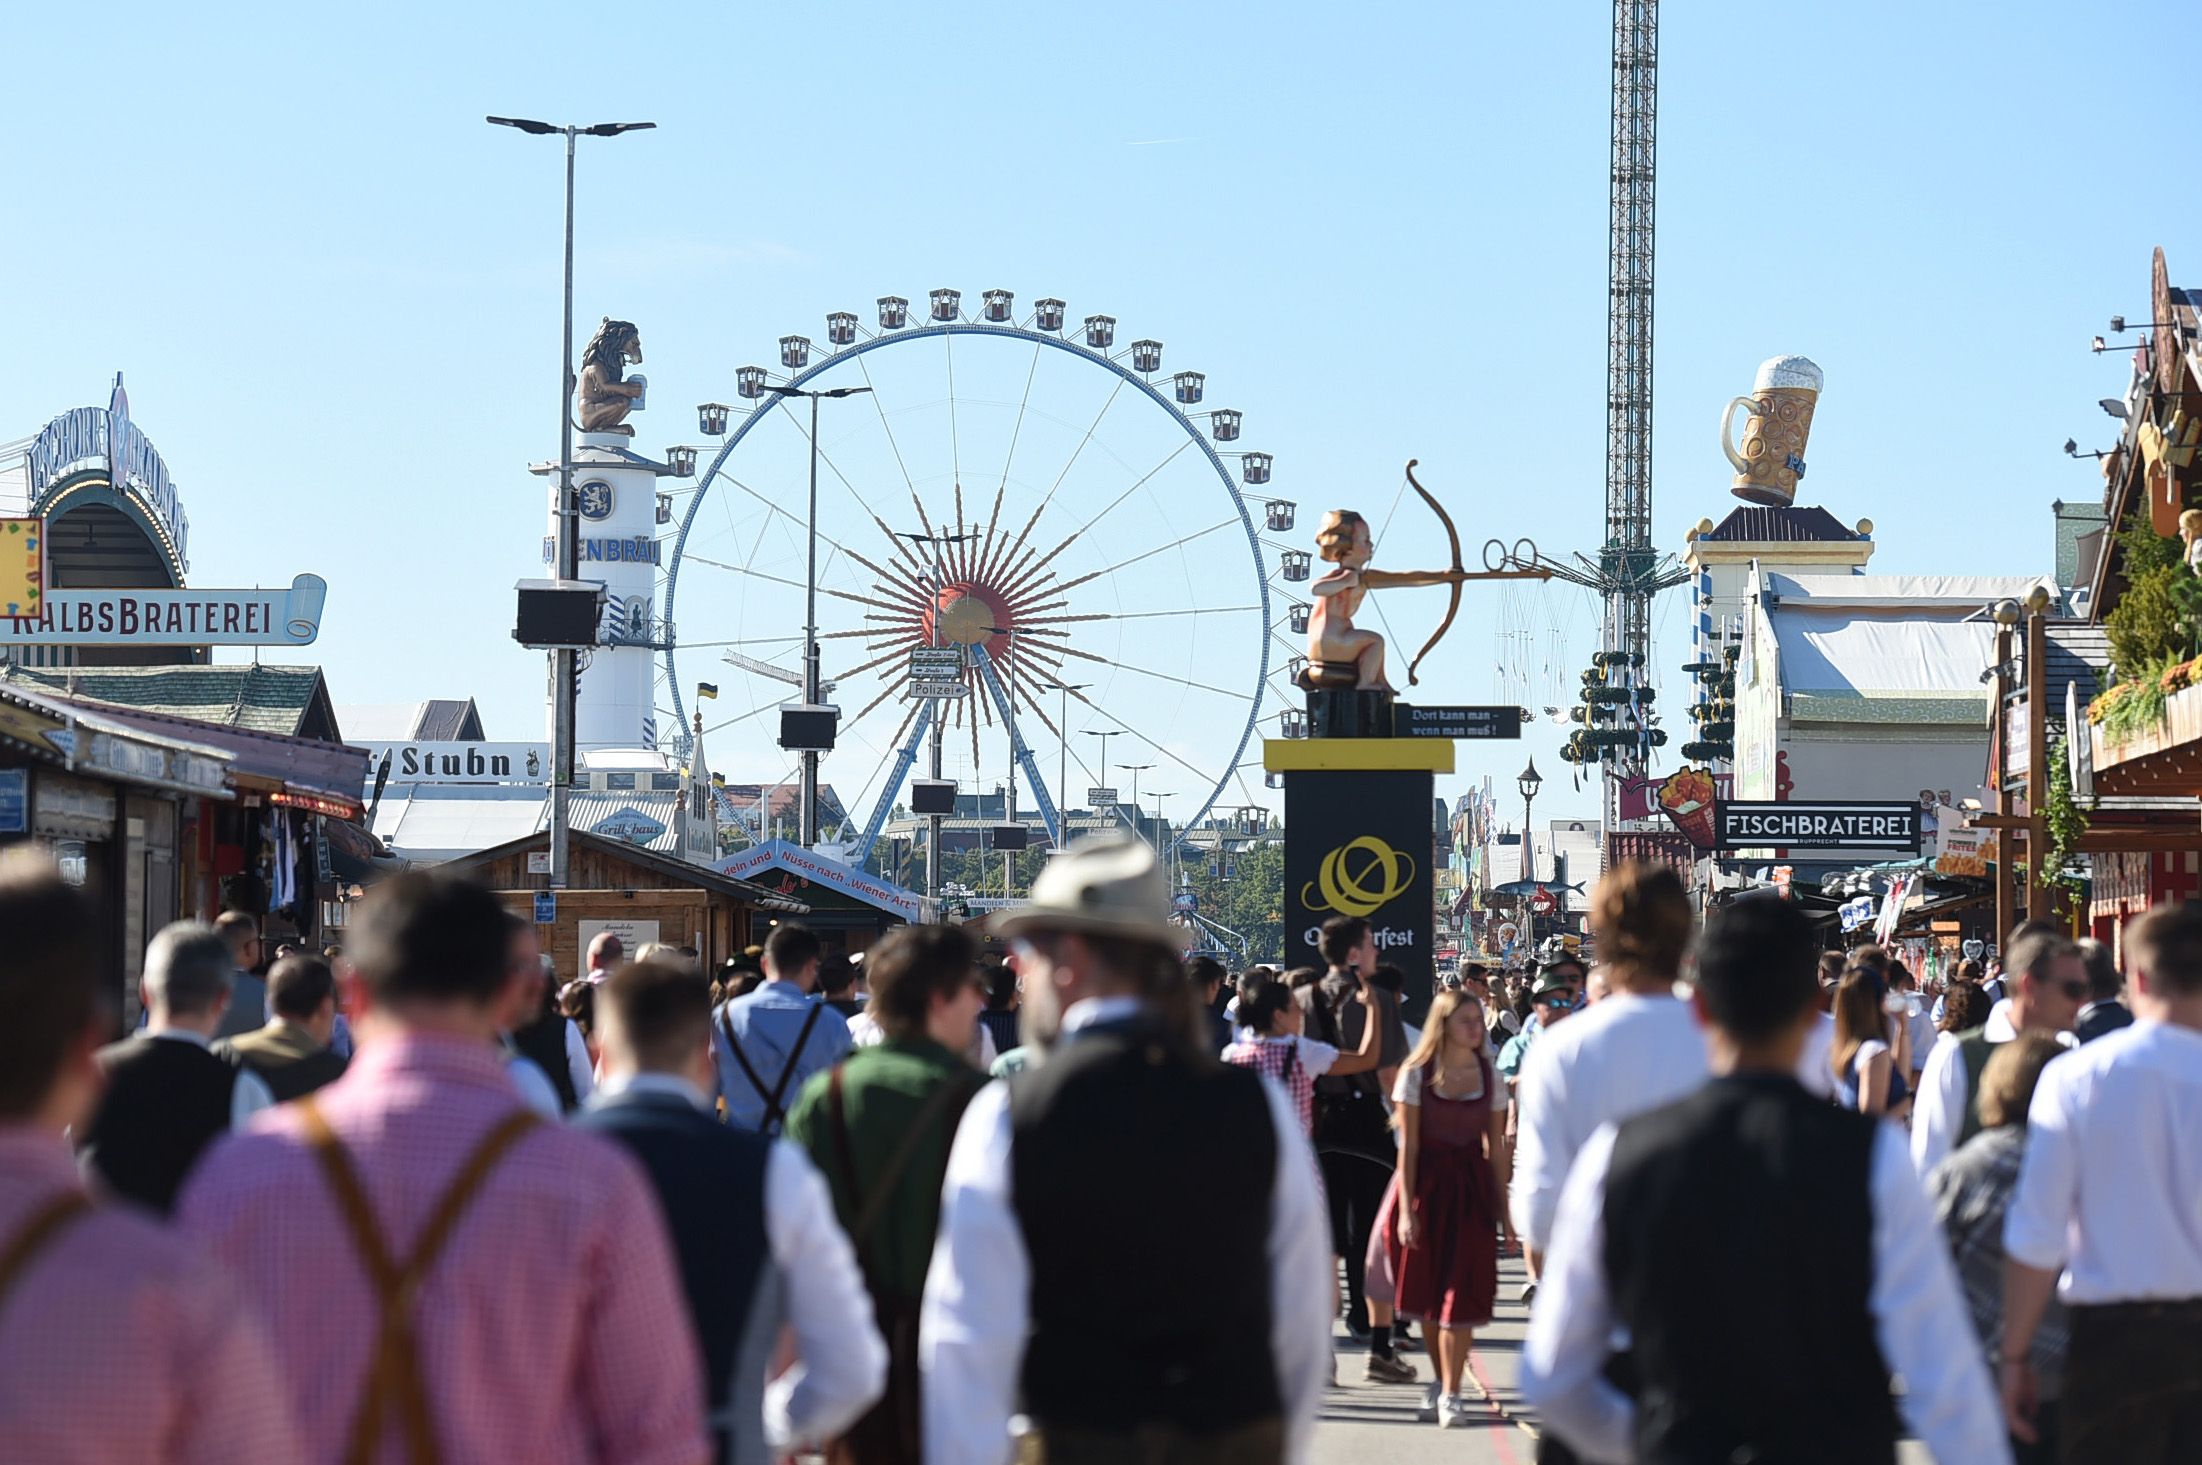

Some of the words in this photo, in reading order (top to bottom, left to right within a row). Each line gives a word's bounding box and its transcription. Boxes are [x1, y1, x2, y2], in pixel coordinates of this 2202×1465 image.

[915, 684, 954, 695] Polizei
[1412, 710, 1437, 720] Dort
[1440, 710, 1465, 720] kann
[1467, 712, 1490, 720] man
[1412, 727, 1440, 735] wenn
[1442, 727, 1464, 735] man
[402, 747, 511, 776] Stubn
[598, 823, 625, 834] Grill
[632, 823, 659, 834] haus
[1726, 815, 1911, 835] FISCHBRATEREI
[750, 851, 772, 867] und
[781, 850, 815, 871] Nüsse
[816, 865, 844, 883] nach
